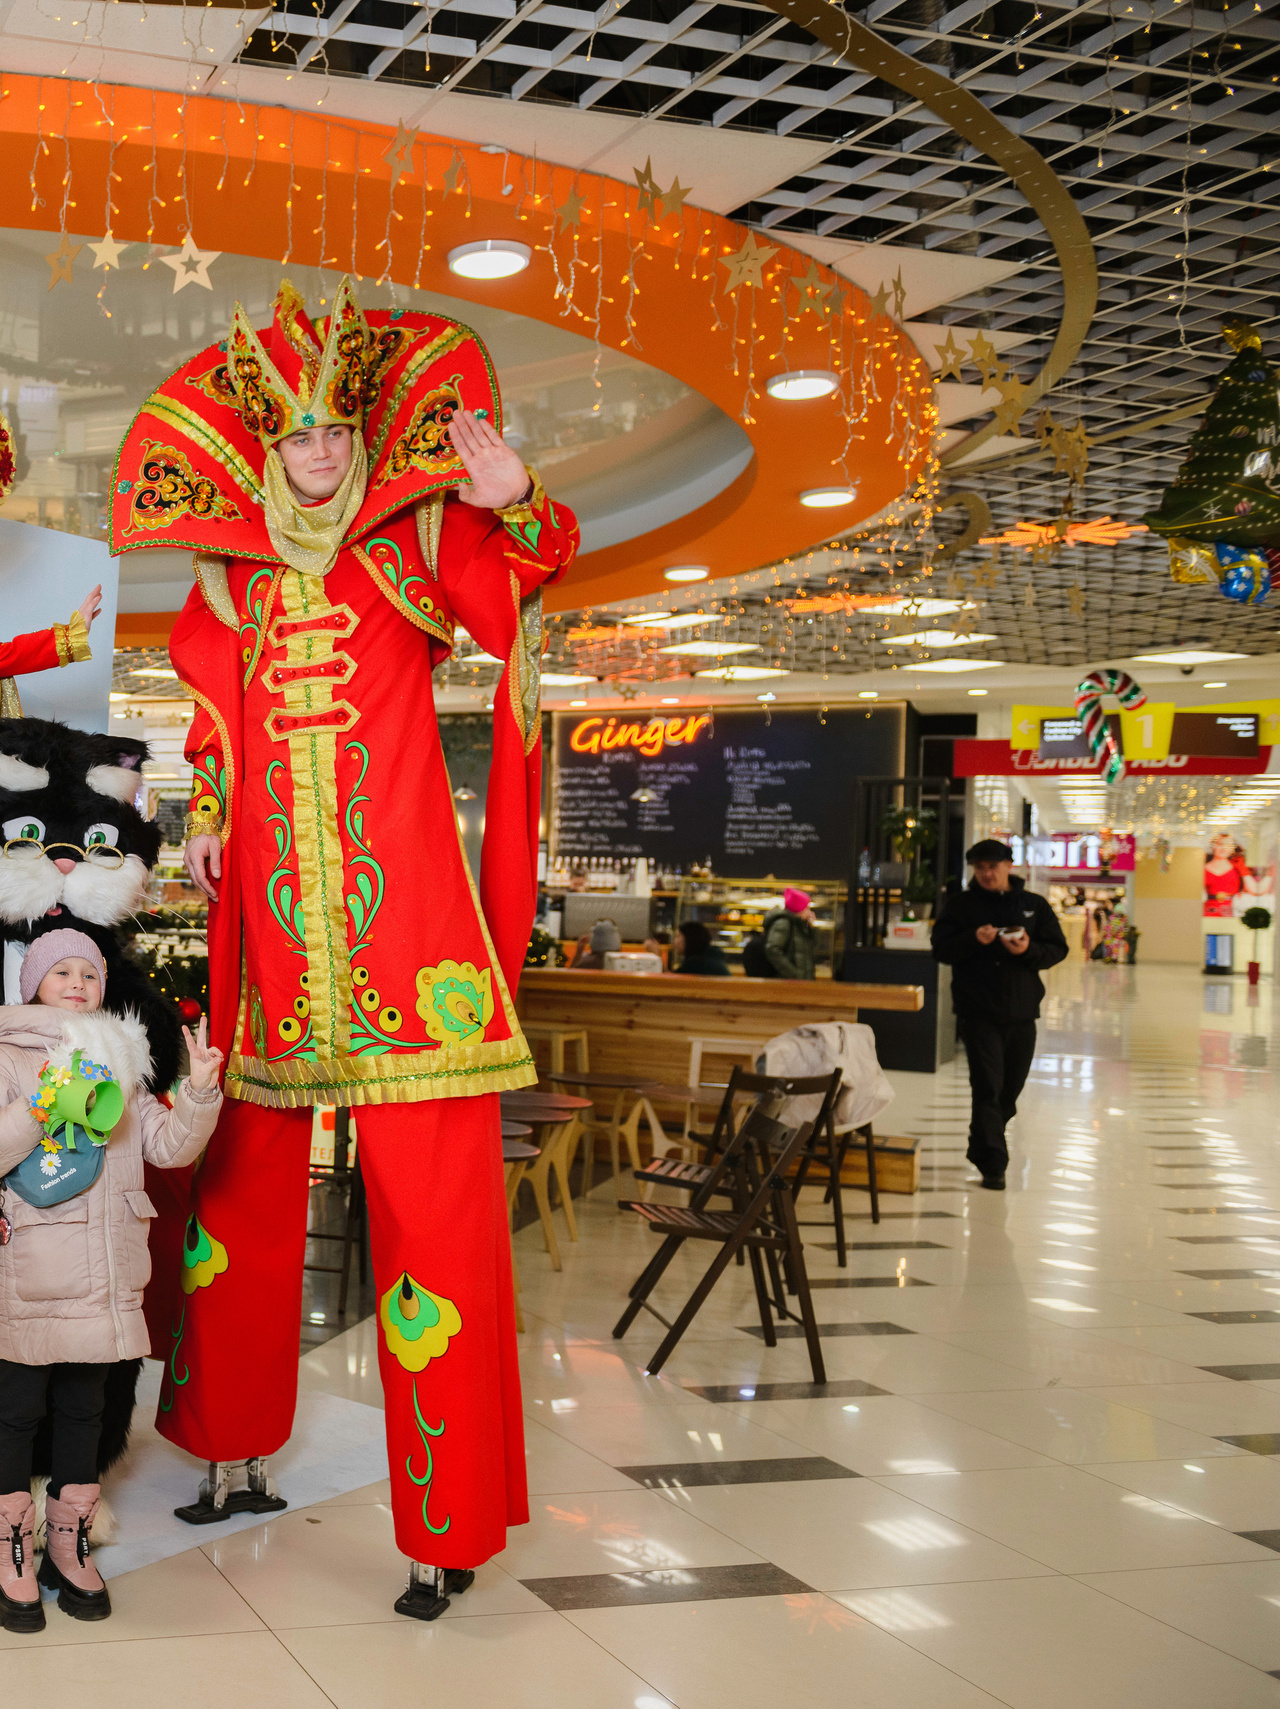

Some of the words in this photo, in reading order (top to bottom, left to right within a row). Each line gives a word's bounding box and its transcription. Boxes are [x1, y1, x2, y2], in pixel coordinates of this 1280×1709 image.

[570, 716, 710, 756] Ginger
[1135, 714, 1153, 748] 1
[40, 1178, 60, 1190] Fashion
[60, 1167, 76, 1180] trends
